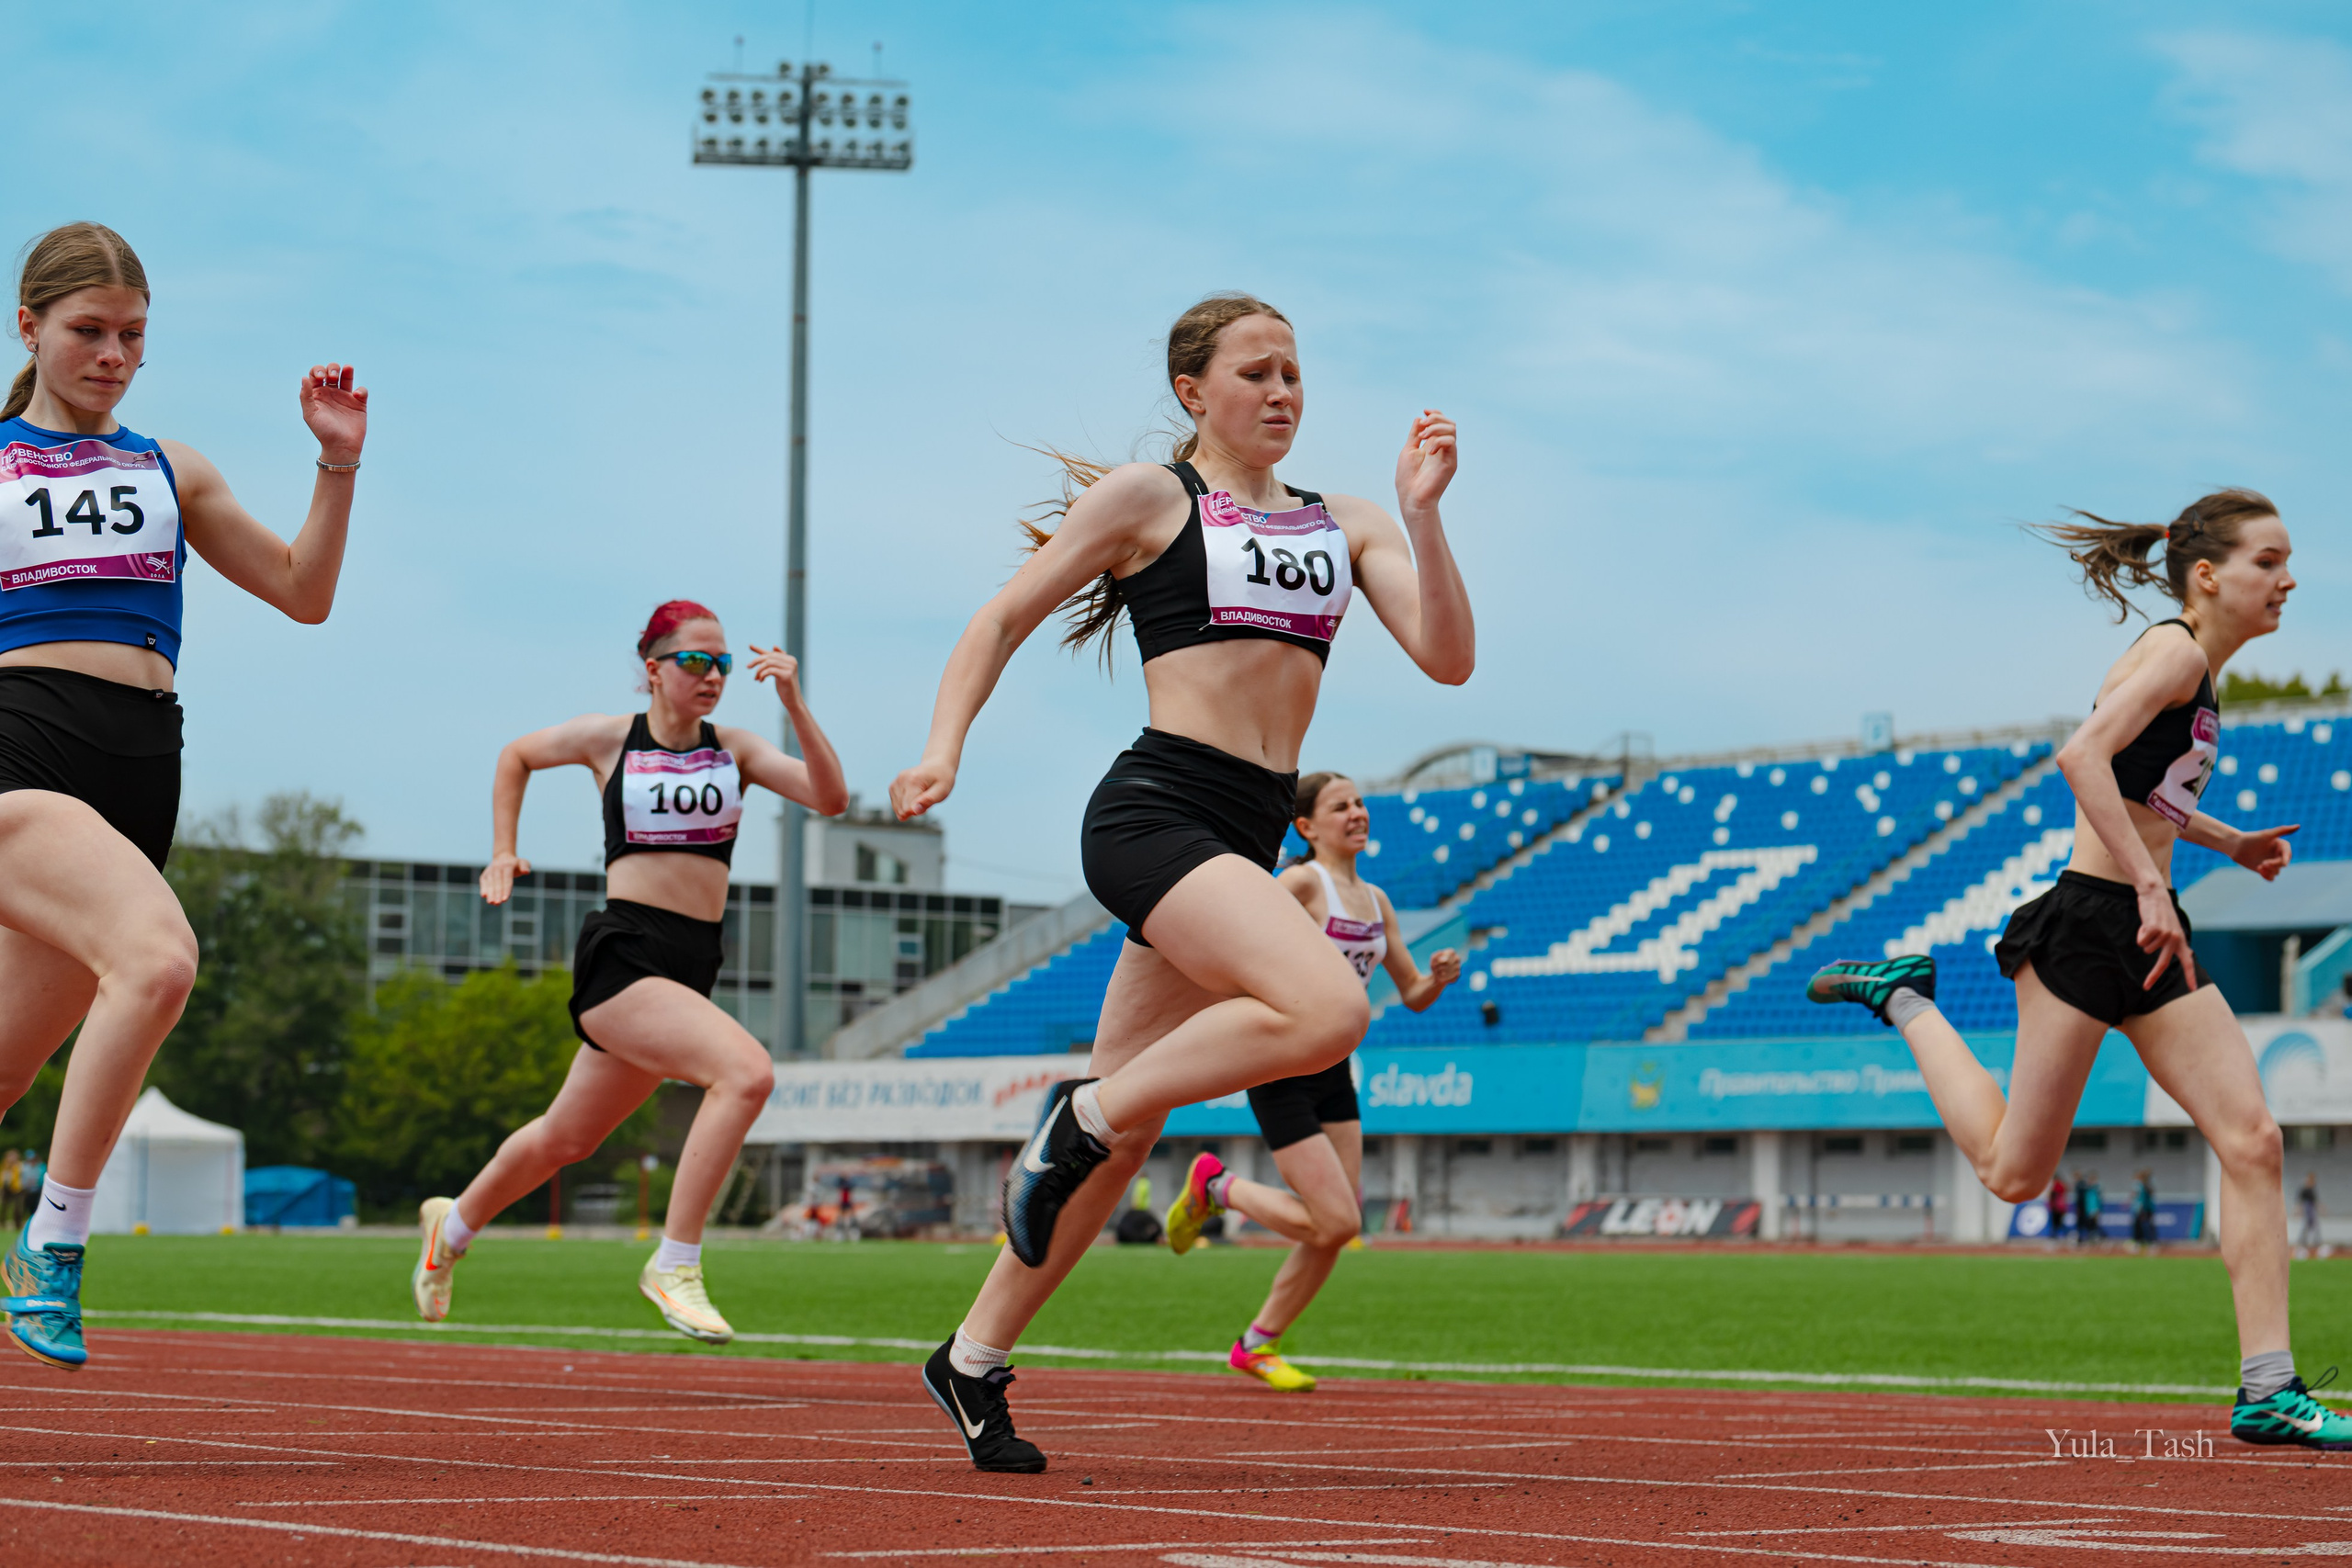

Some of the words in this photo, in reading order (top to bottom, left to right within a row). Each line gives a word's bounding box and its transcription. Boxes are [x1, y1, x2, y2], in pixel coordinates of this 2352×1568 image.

[1, 448, 73, 465] ПЕРВЕНСТВО
[70, 456, 121, 467] ФЕДЕРАЛЬНОГО
[25, 486, 144, 538] 145
[1211, 496, 1267, 524] ПЕРСТВО
[12, 564, 97, 584] ВЛАДИВОСТОК
[1241, 537, 1335, 596] 180
[1220, 611, 1292, 629] ВЛАДИВОСТОК
[649, 783, 723, 816] 100
[1368, 1061, 1474, 1108] slavda
[1600, 1198, 1725, 1235] LEON
